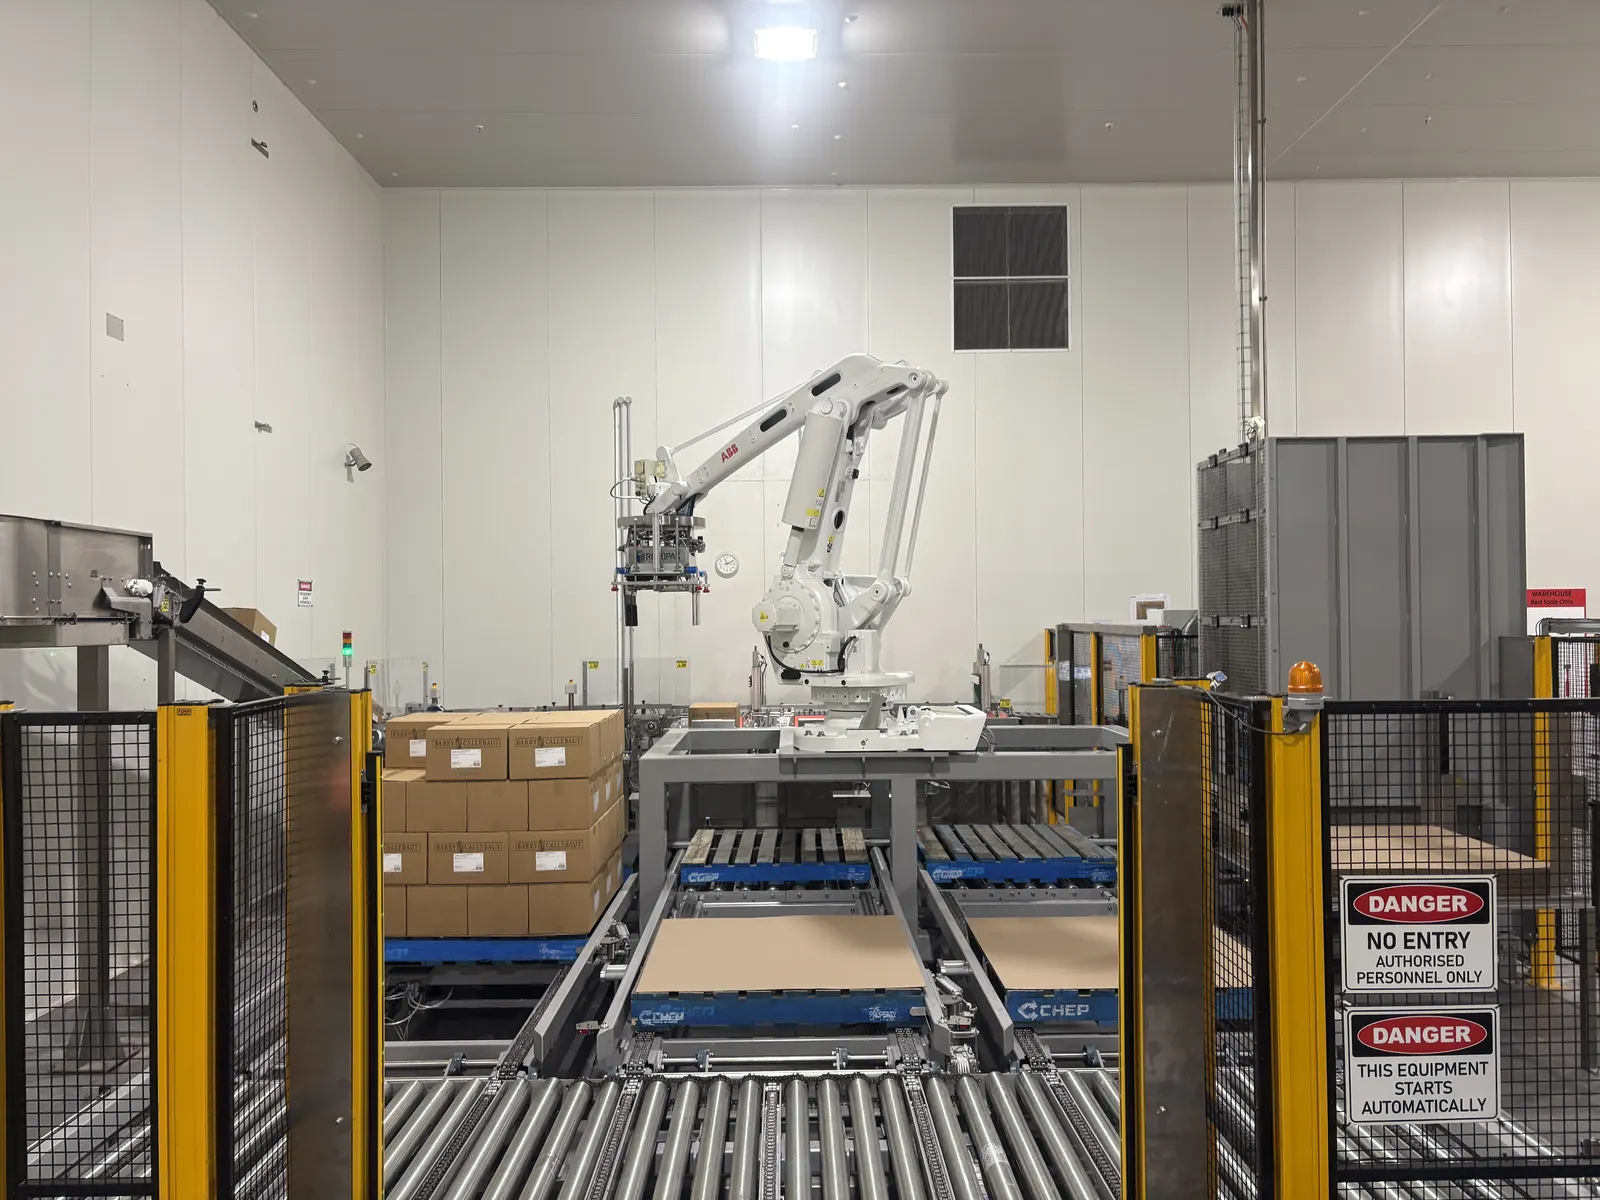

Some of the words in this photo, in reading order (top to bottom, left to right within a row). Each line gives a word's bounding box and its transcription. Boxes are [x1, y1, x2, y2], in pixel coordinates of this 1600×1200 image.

[721, 443, 739, 463] ABB
[462, 739, 500, 747] CALLEBAUT
[545, 737, 580, 745] CALLEBAUT
[1369, 895, 1468, 913] DANGER
[1367, 932, 1397, 950] NO
[1404, 931, 1471, 950] ENTRY
[1376, 955, 1464, 967] AUTHORISED
[1357, 971, 1442, 984] PERSONNEL
[1446, 971, 1482, 983] ONLY
[1040, 1004, 1090, 1016] CHEP
[1373, 1026, 1471, 1044] DANGER
[1357, 1063, 1393, 1078] THIS
[1397, 1062, 1489, 1077] EQUIPMENT
[1394, 1080, 1453, 1095] STARTS
[1361, 1098, 1487, 1114] AUTOMATICALLY
